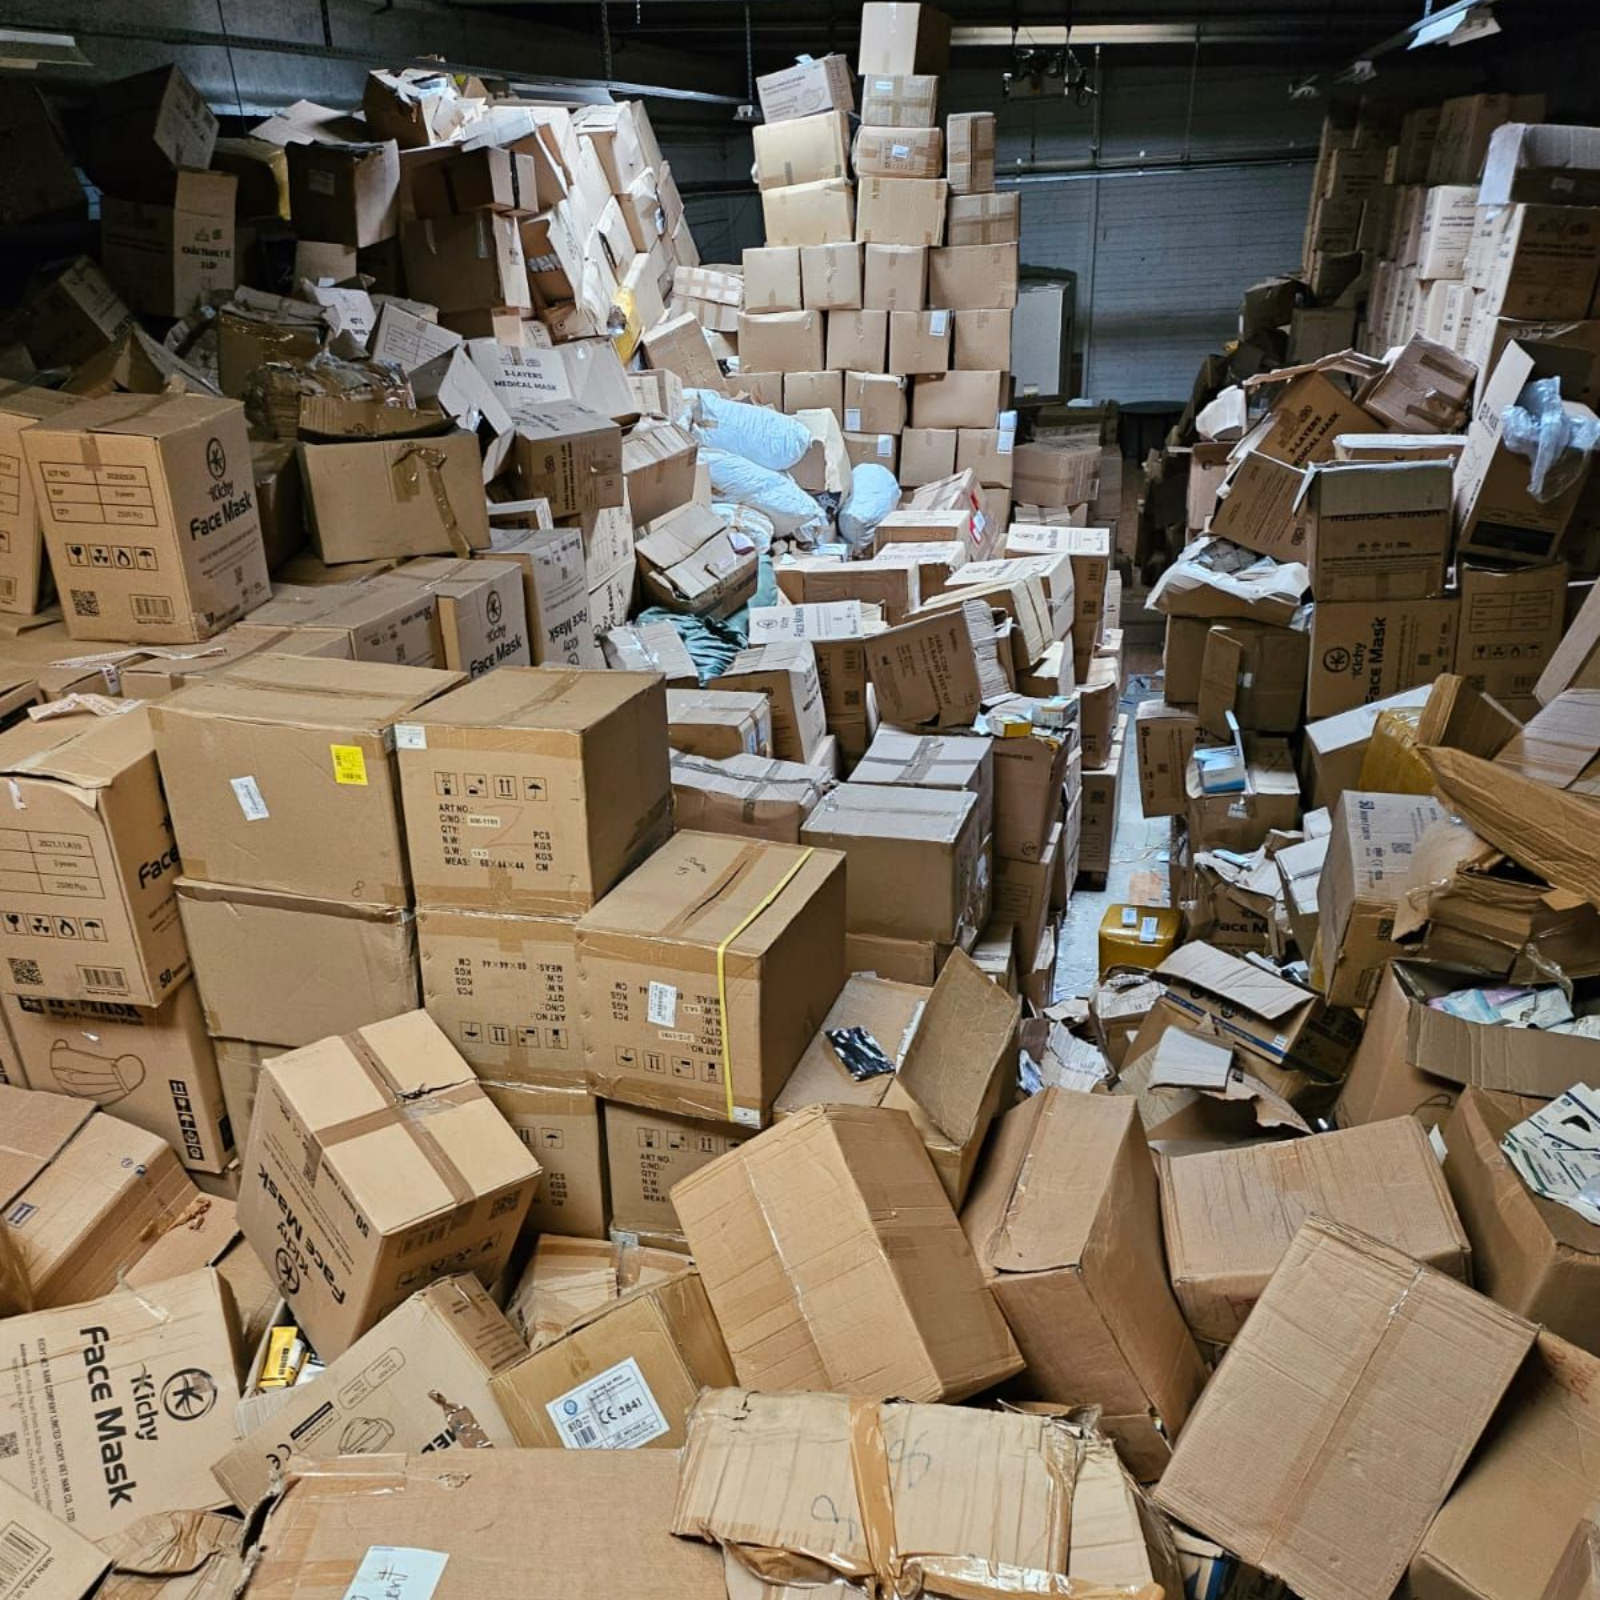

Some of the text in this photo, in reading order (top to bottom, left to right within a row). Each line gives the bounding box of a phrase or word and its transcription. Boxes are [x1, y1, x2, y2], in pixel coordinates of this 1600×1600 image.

[190, 490, 253, 540] Face Mask
[547, 616, 573, 644] Mask
[1368, 616, 1386, 663] Mask
[470, 634, 522, 678] Face Mask
[533, 830, 550, 841] PCS
[533, 841, 552, 851] KGS
[535, 852, 554, 861] KGS
[535, 863, 549, 872] CM
[458, 958, 471, 967] CM
[454, 967, 472, 977] KGS
[160, 968, 173, 988] 50
[455, 977, 472, 986] KGS
[457, 986, 473, 996] PCS
[615, 982, 628, 991] CM
[610, 992, 628, 1001] KGS
[611, 1001, 628, 1011] KGS
[550, 1013, 566, 1022] ART
[613, 1011, 628, 1021] PCS
[355, 1214, 370, 1238] 50
[258, 1163, 346, 1305] Face Mask
[130, 1363, 159, 1441] Kichy
[80, 1326, 137, 1510] Face Mask
[22, 1574, 39, 1589] Viet
[36, 1556, 54, 1575] Nam
